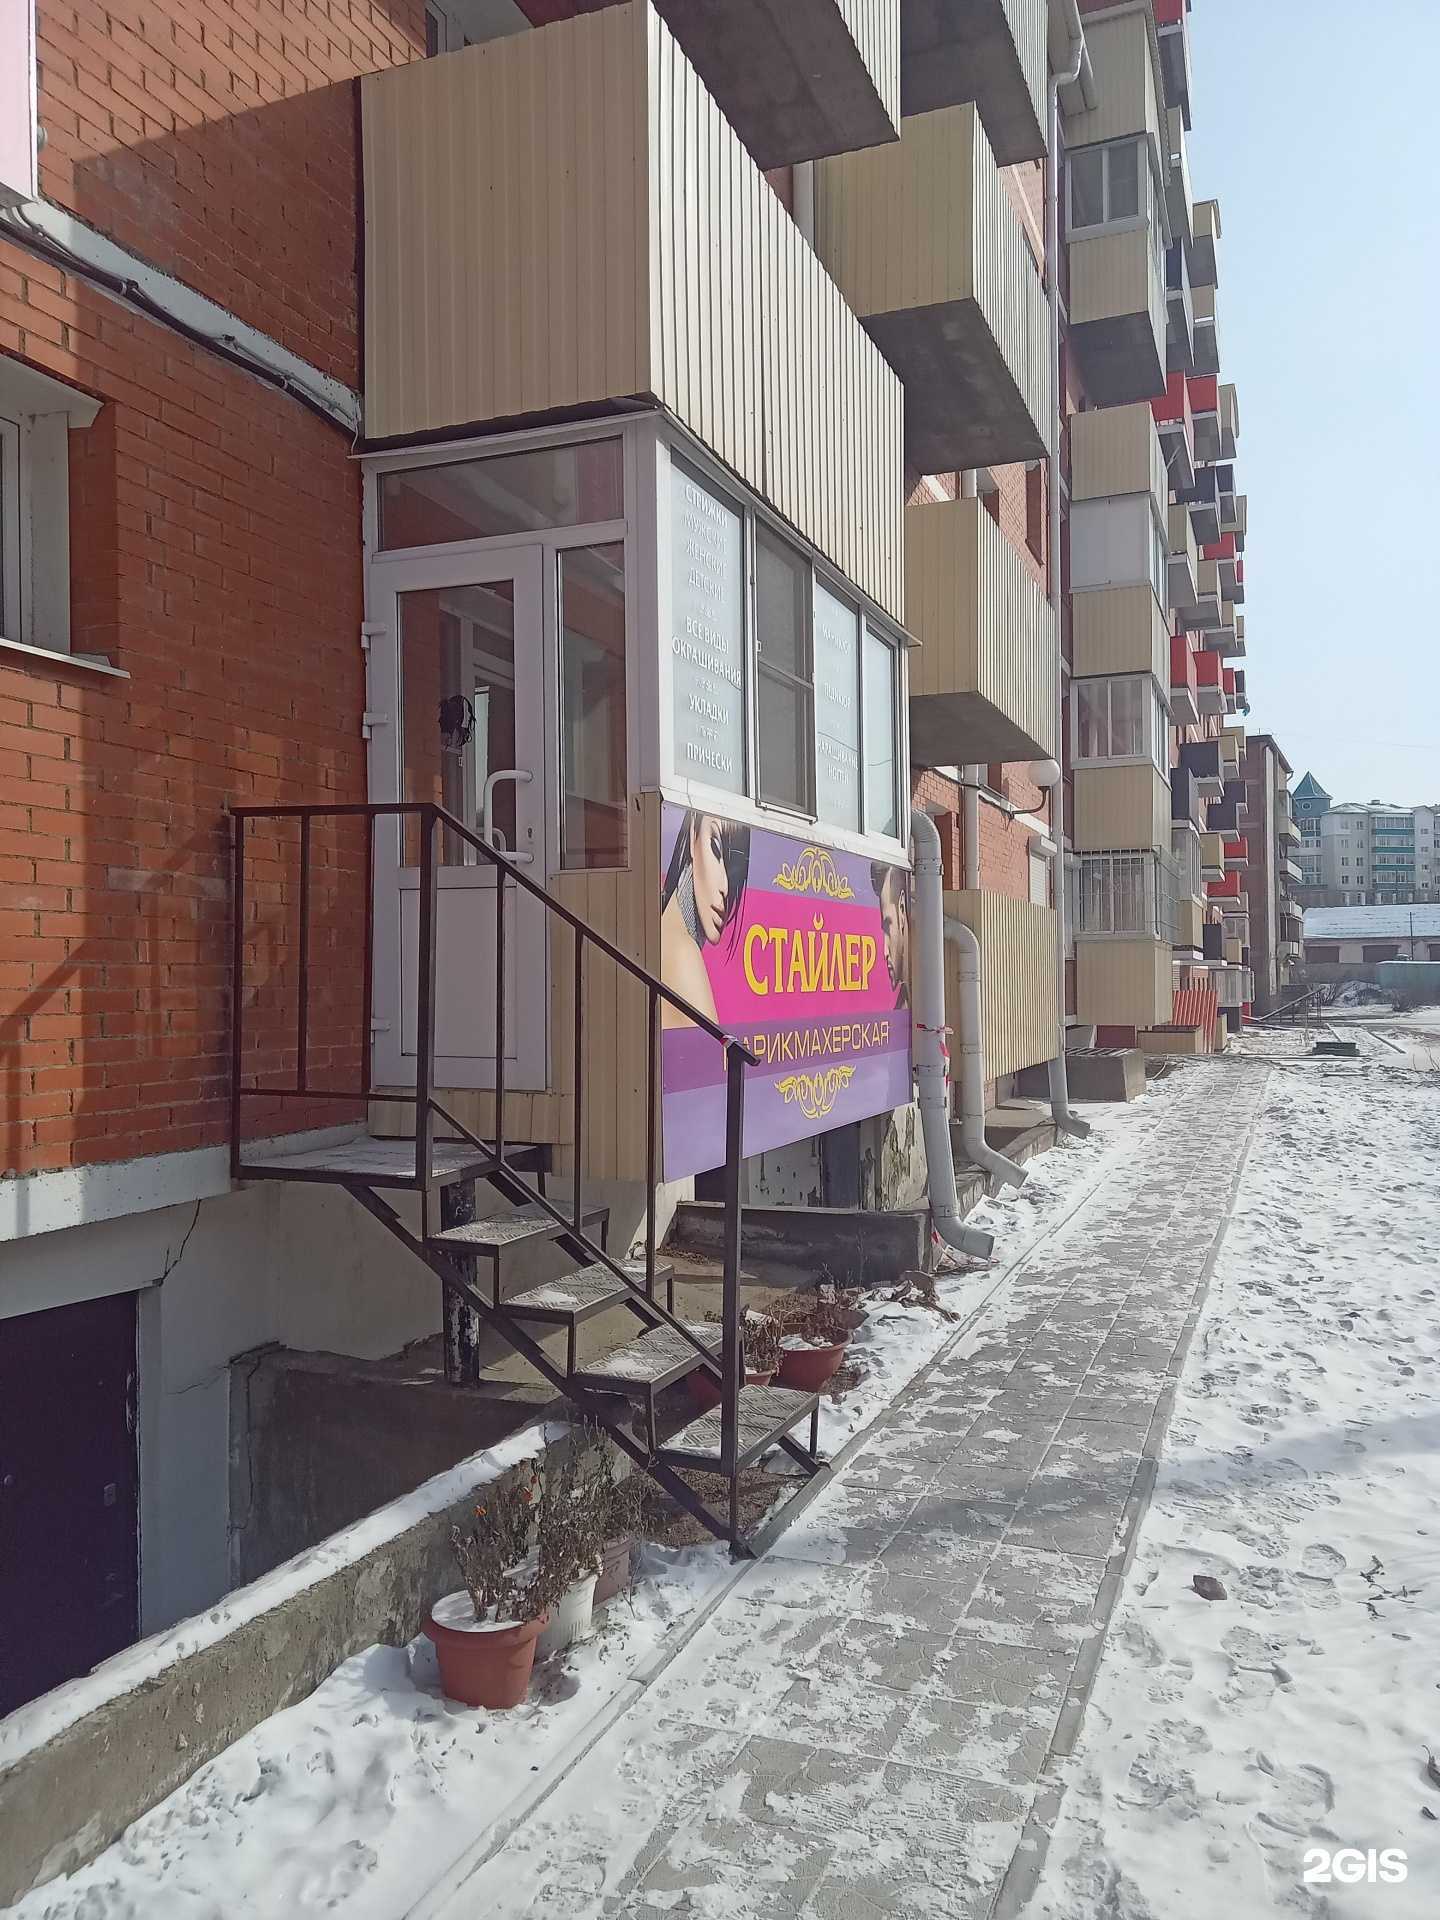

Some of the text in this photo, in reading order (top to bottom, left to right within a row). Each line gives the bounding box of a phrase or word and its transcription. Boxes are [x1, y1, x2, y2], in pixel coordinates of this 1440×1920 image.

[684, 484, 728, 529] СТРИЖКИ
[686, 616, 729, 654] ВСЕ ВИДЫ
[672, 636, 742, 687] ОКРАШИВАНИЯ
[688, 693, 729, 725] УКЛАДКИ
[687, 742, 733, 774] ПРИЧЕСКИ
[743, 912, 877, 996] СТАЙЛЕР
[723, 1021, 889, 1071] РИКМАХЕРСКАЯ
